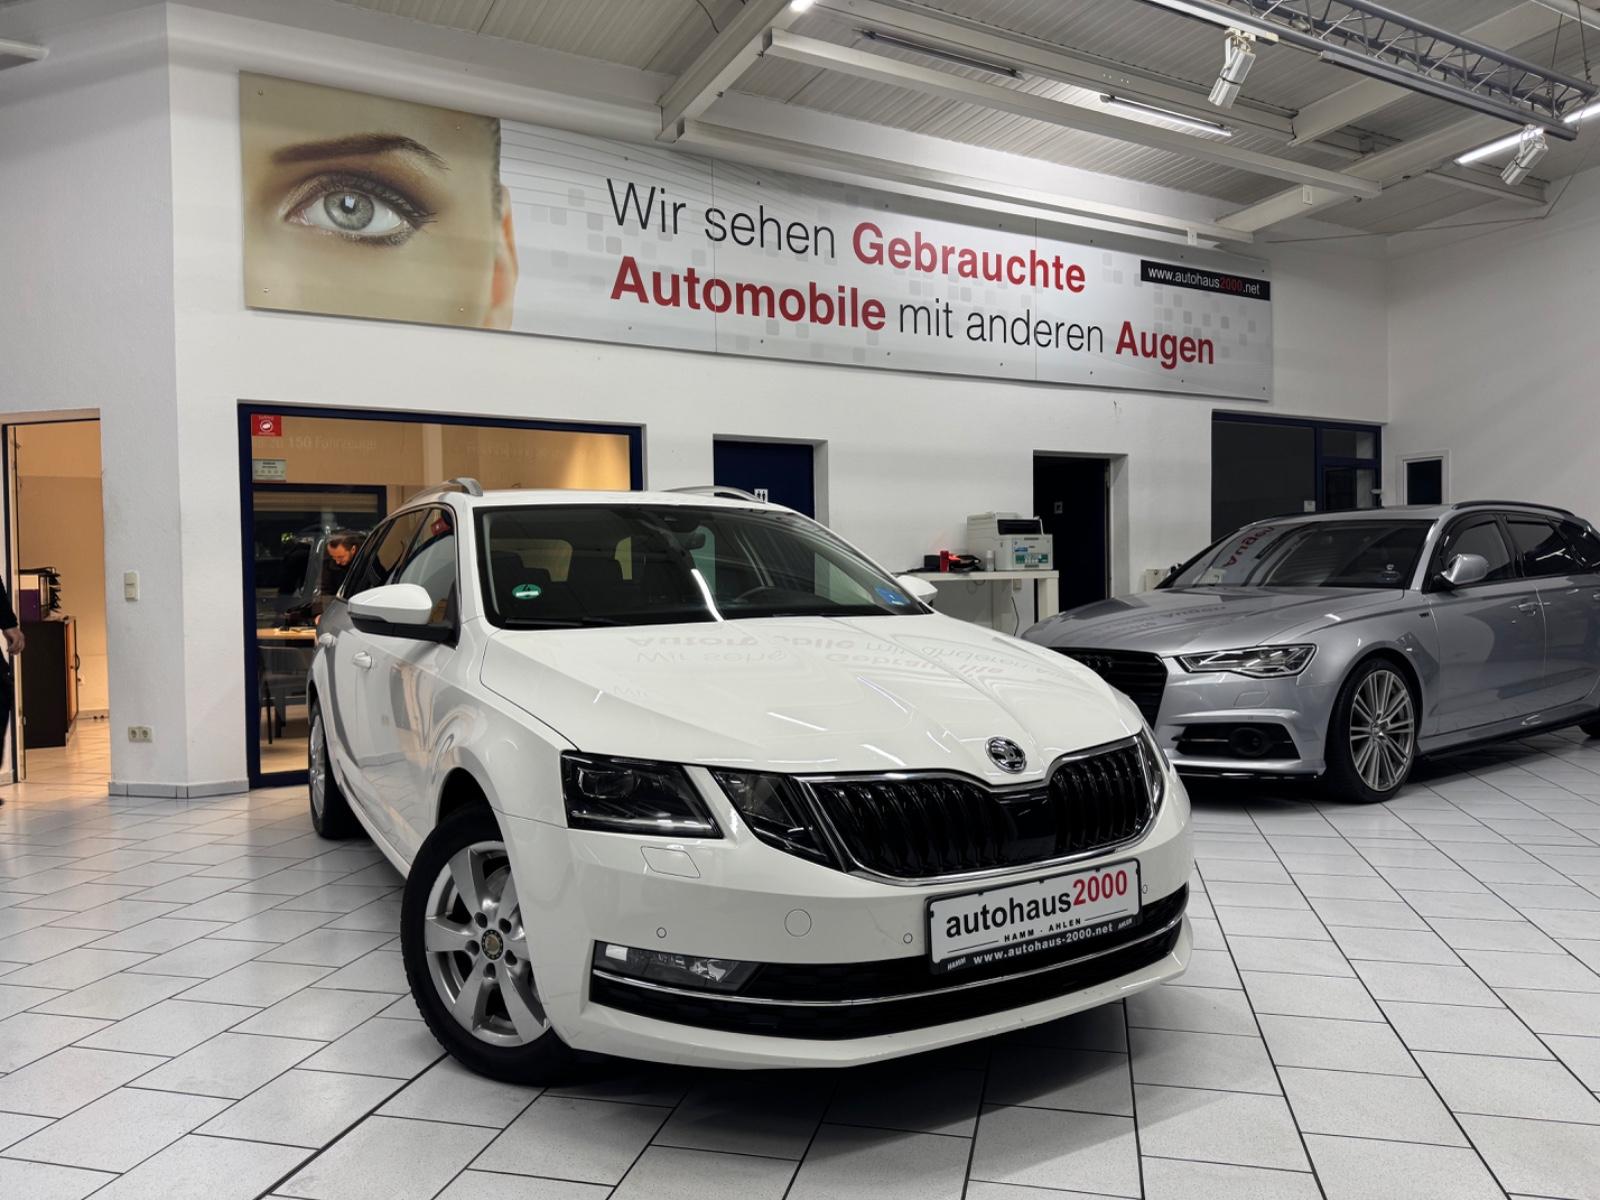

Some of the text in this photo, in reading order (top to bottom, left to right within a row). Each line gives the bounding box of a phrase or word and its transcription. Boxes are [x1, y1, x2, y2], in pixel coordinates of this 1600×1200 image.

[606, 177, 1085, 293] Wir sehen Gebrauchte
[1147, 267, 1261, 295] www.autohaus2000.net
[610, 255, 1214, 370] Automobile mit anderen Augen
[945, 869, 1128, 938] autohaus2000
[1004, 917, 1082, 943] HAMM AHLEN
[972, 922, 1114, 965] www.autohaus-2000.net
